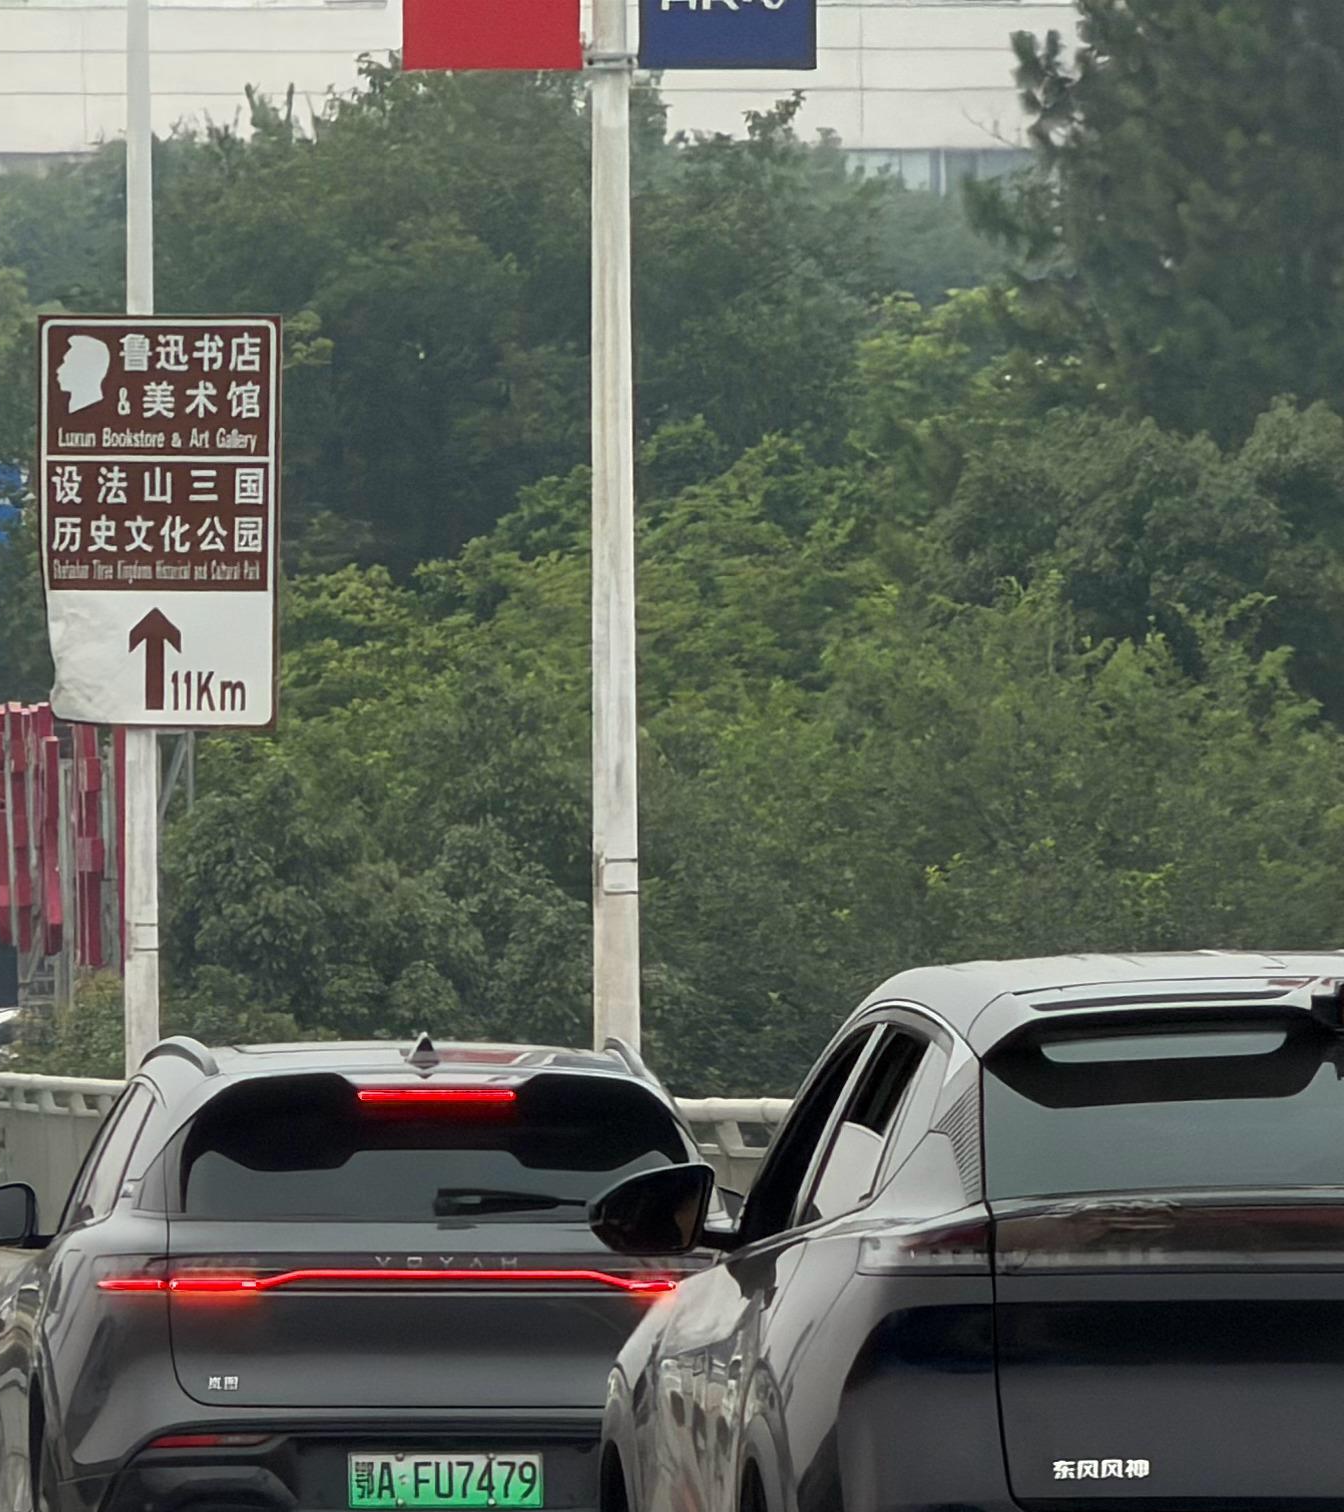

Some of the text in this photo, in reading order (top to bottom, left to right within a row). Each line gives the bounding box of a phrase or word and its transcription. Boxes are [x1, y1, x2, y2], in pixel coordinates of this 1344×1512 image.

[119, 333, 261, 372] 鲁迅书店
[102, 428, 165, 448] Bookstore
[189, 428, 209, 448] Art
[216, 428, 258, 453] Gallery
[51, 465, 265, 505] 设法山三国
[51, 514, 263, 553] 历史文化公园
[171, 671, 247, 712] 11Km
[1053, 1459, 1150, 1480] 东风风神
